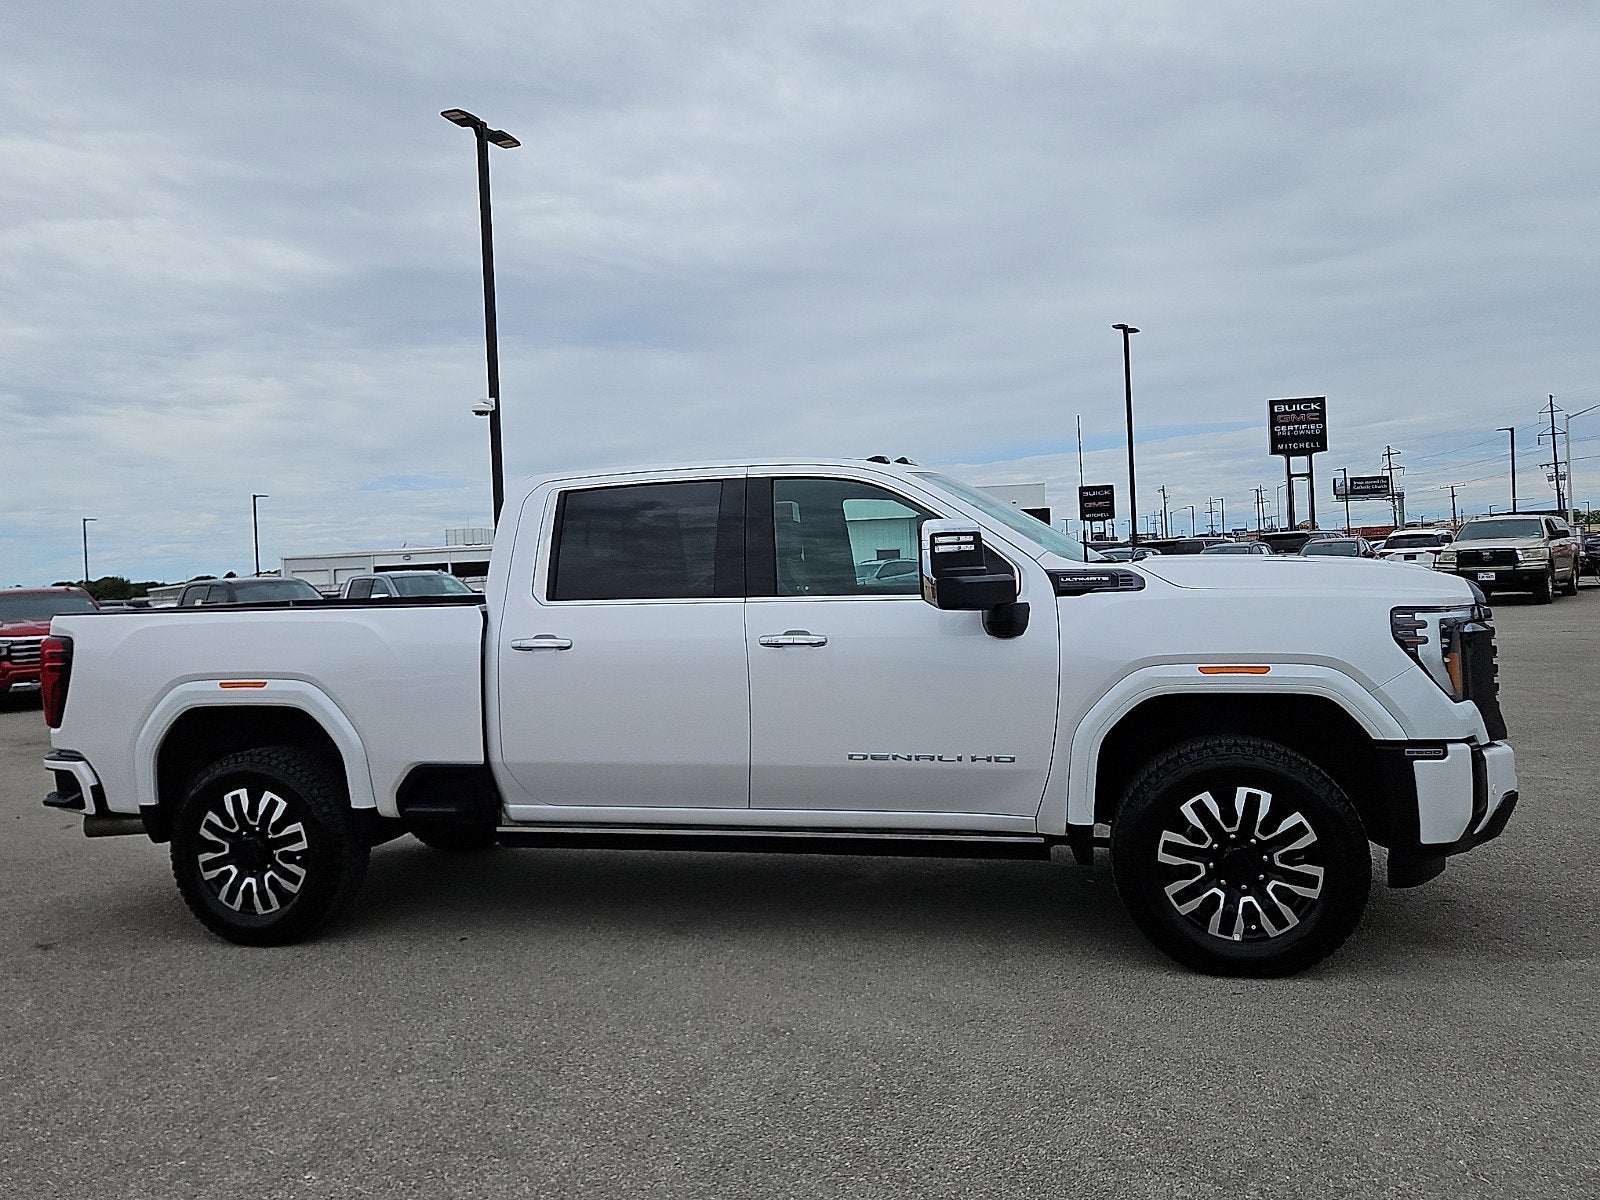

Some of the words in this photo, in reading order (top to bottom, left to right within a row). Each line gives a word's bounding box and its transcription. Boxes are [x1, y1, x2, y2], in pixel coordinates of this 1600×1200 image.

[1274, 402, 1322, 412] BUICK
[1277, 412, 1320, 422] GMC
[1274, 423, 1323, 432] CERTIFIED
[1277, 441, 1321, 450] MITCHELL
[848, 752, 962, 763] DENALI
[971, 753, 1016, 763] HD
